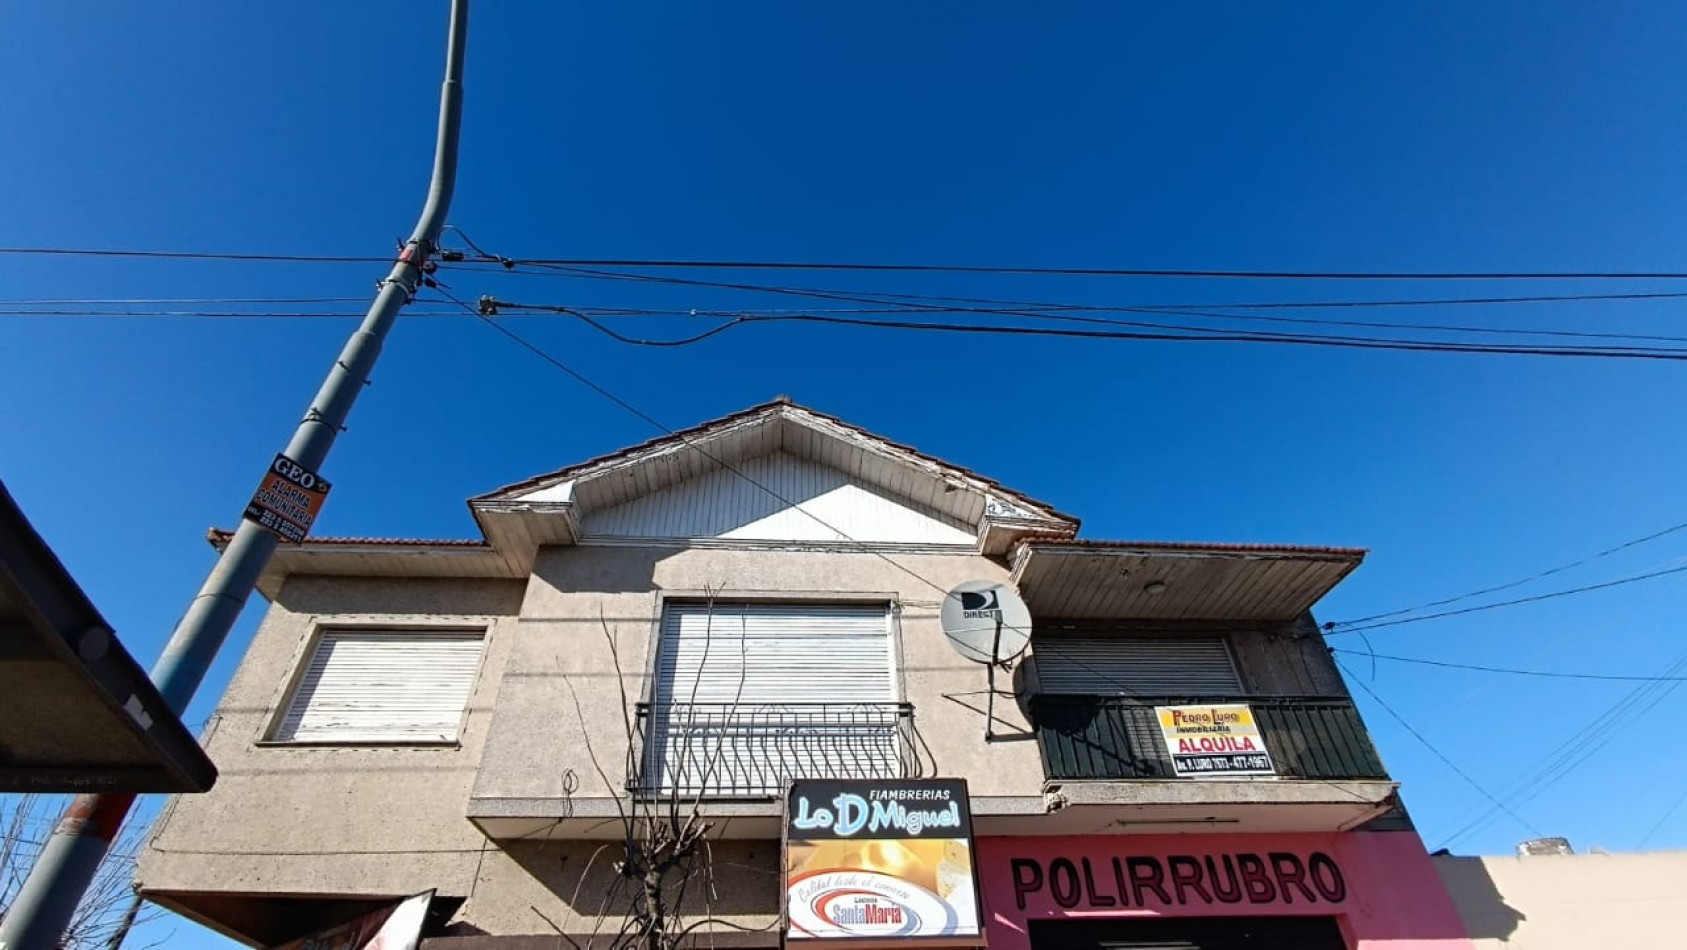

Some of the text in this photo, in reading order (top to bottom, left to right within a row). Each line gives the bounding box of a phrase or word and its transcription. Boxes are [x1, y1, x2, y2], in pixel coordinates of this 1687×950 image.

[274, 458, 316, 489] GEO
[272, 480, 312, 509] ALARMA
[257, 490, 313, 529] COMUNITARIA
[964, 610, 994, 619] DIRECT
[1176, 725, 1231, 734] INMOBILIARIA
[1179, 736, 1256, 753] ALQUILA
[1194, 757, 1212, 770] LURO
[869, 789, 951, 801] FIAMBRERIAS
[793, 792, 961, 836] Lo D Miguel
[1010, 851, 1346, 911] POLIRRUBRO
